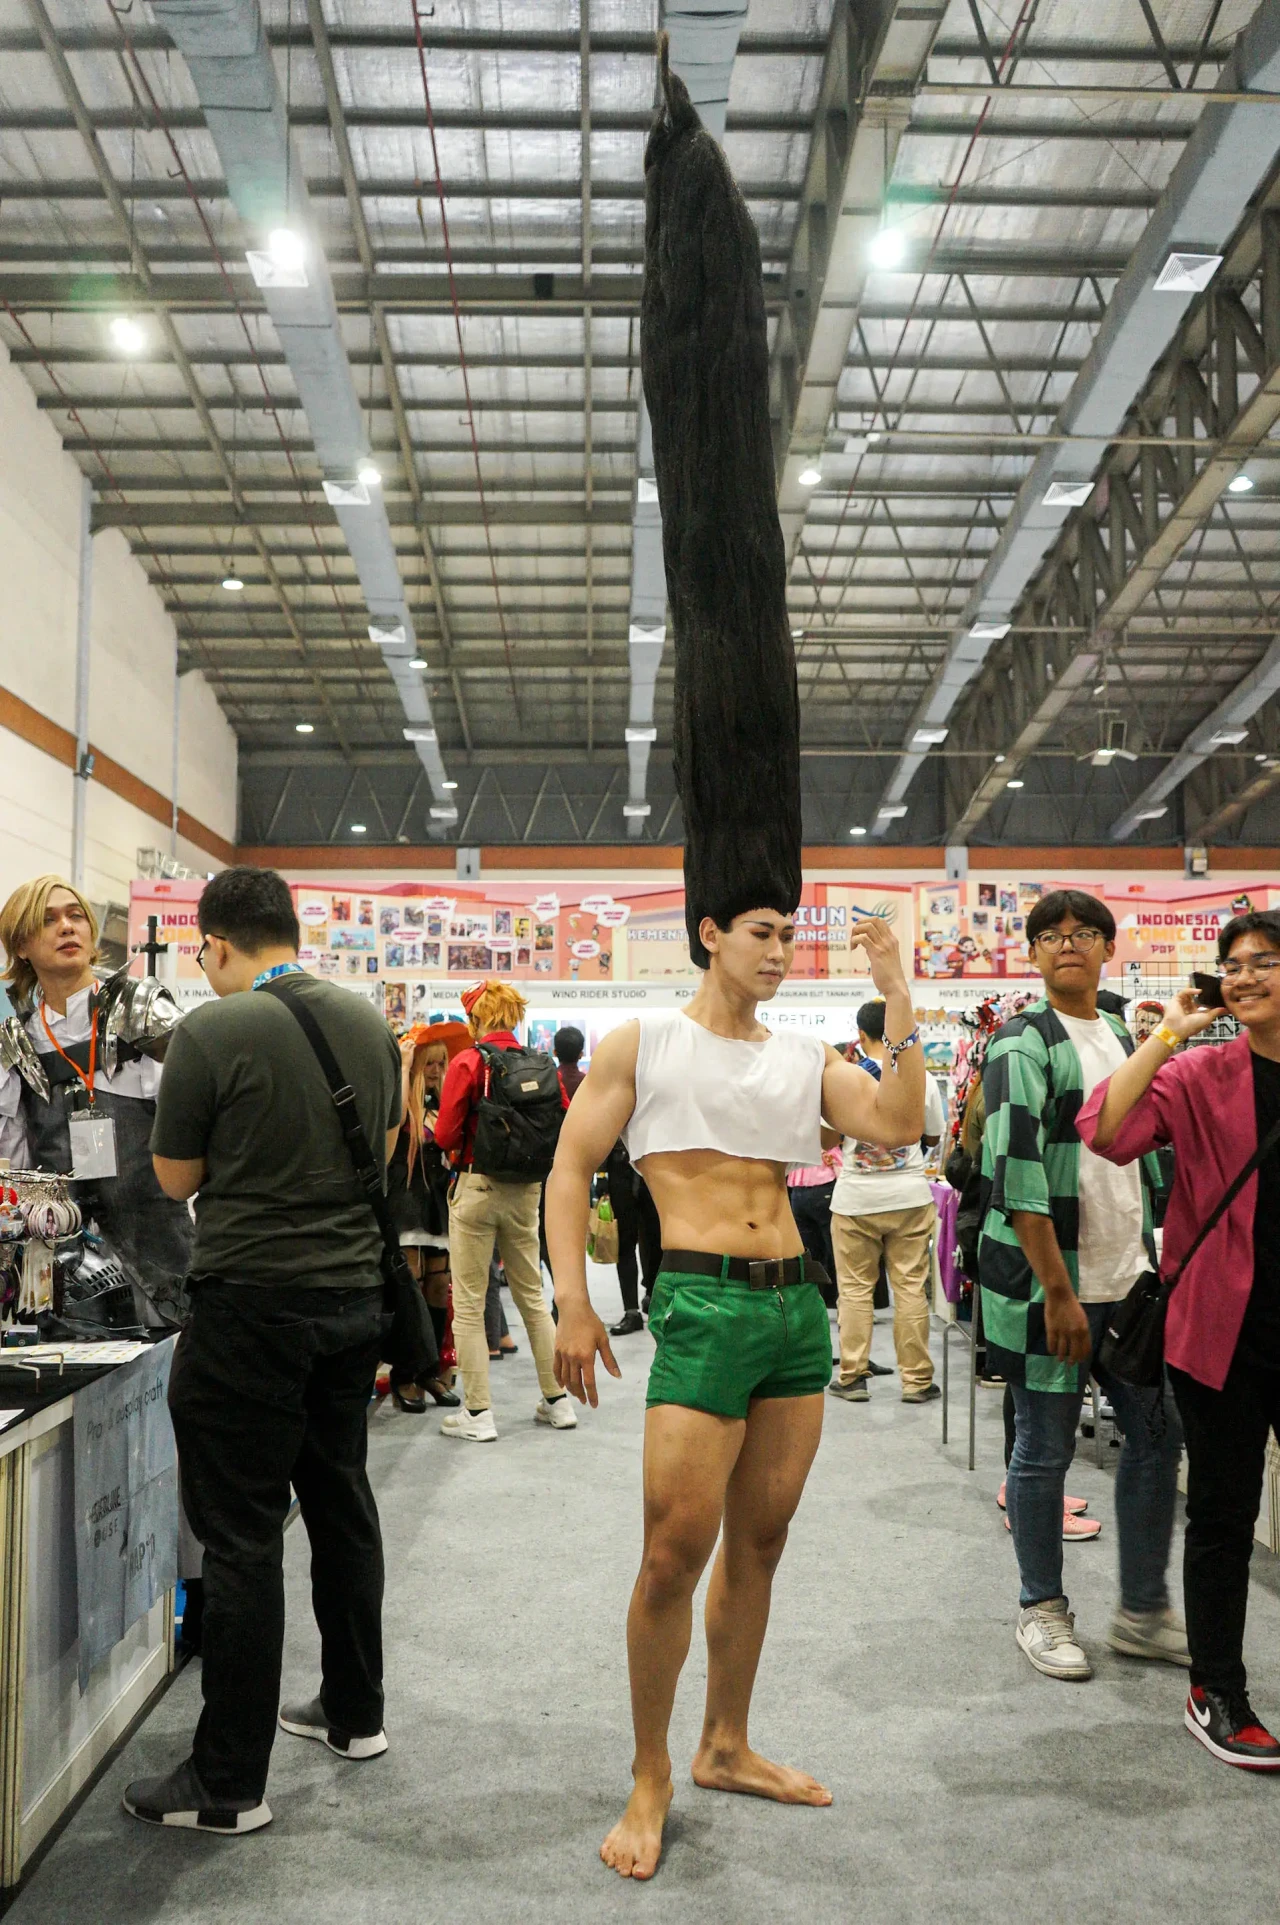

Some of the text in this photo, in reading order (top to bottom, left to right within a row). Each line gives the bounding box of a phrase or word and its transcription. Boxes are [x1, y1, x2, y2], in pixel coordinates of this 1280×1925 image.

[793, 905, 847, 927] IUN
[1136, 914, 1220, 926] INDONESIA
[627, 928, 690, 942] KEMENT
[793, 929, 848, 942] ANGAN
[1127, 927, 1187, 942] COMIC
[1150, 944, 1176, 954] POP
[432, 991, 459, 999] MEDIA
[552, 990, 647, 999] WIND RIDER STUDIO
[939, 989, 961, 998] HIVE
